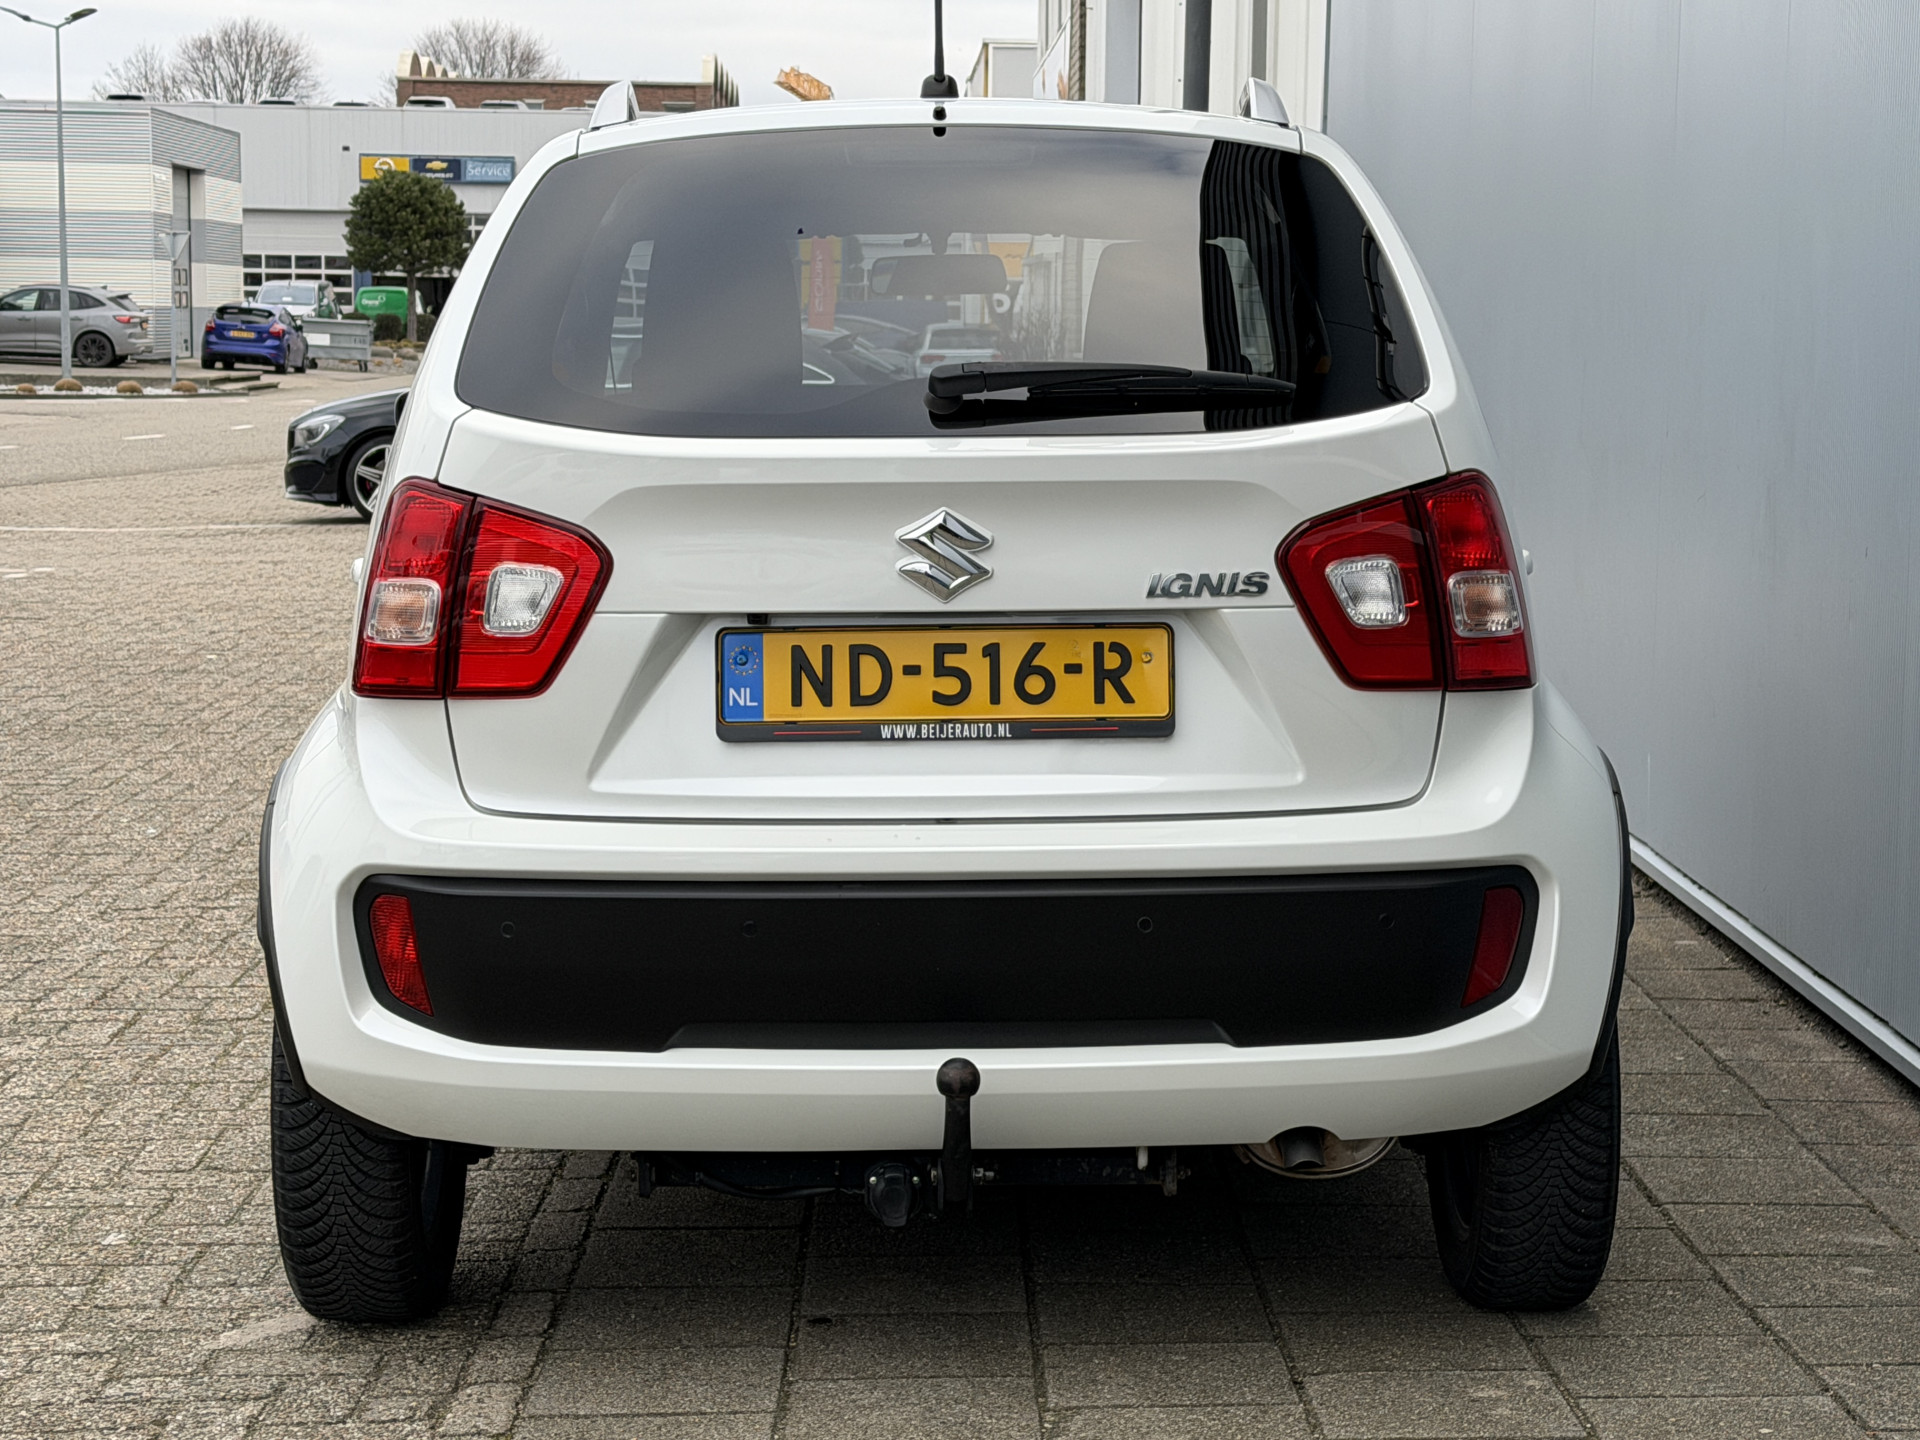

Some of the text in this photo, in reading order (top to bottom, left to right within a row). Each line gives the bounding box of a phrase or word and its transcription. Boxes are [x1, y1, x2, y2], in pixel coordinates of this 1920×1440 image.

[468, 164, 510, 176] Service
[1146, 571, 1270, 598] IGNIS
[790, 641, 1136, 707] ND-516-R
[728, 687, 758, 706] NL
[880, 723, 1012, 739] WWW.BEIJERAUTO.NL
